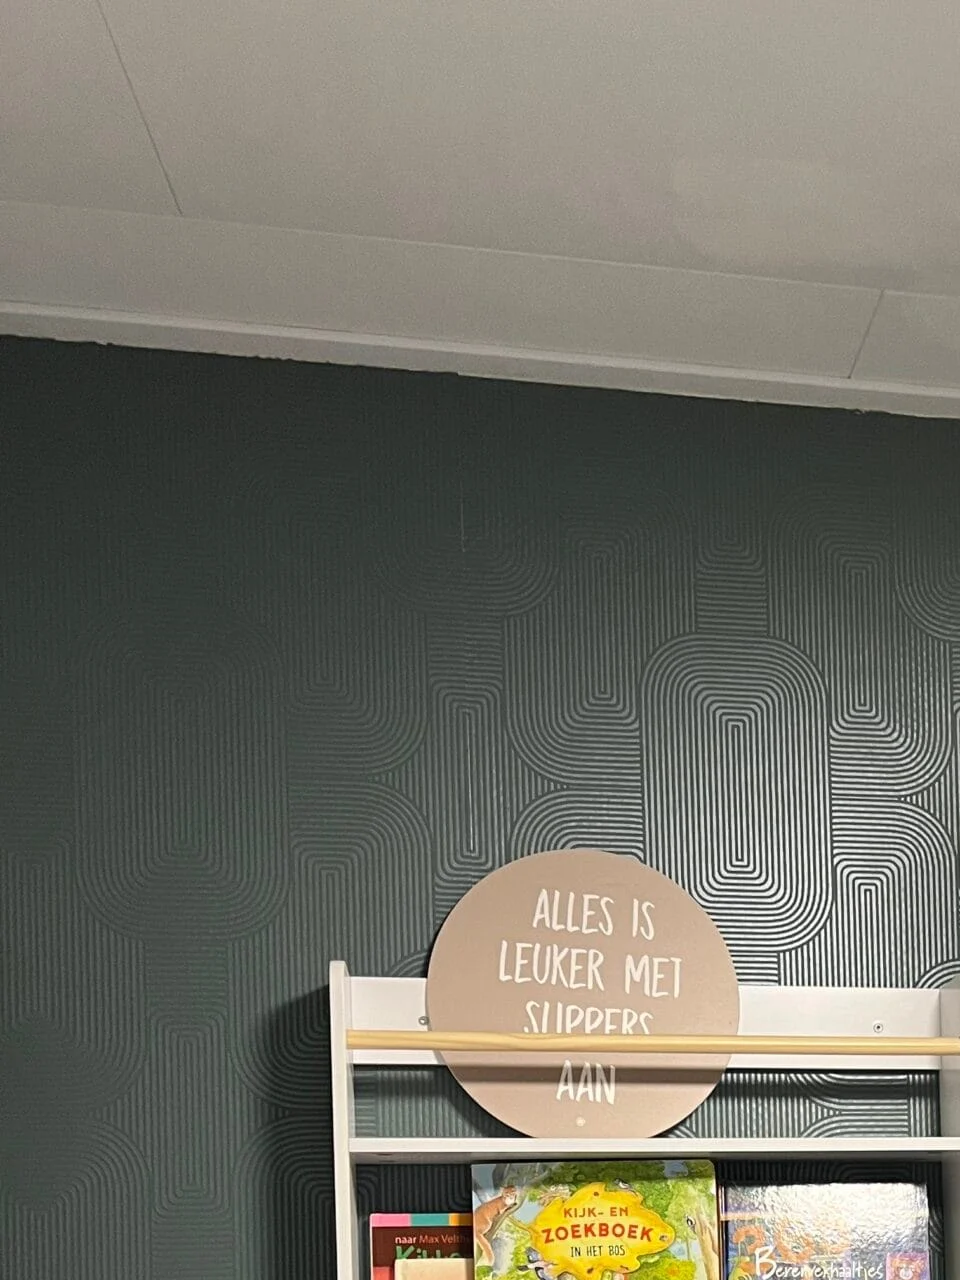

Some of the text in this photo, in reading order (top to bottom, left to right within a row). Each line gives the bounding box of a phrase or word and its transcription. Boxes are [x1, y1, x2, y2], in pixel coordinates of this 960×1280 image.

[533, 889, 656, 940] ALLES IS
[499, 940, 682, 999] LEUKER MET
[556, 1060, 616, 1105] AAN
[609, 1206, 629, 1217] EN
[395, 1235, 417, 1244] naar
[419, 1234, 440, 1244] Max
[541, 1222, 654, 1245] ZOEKBOEK
[570, 1245, 626, 1257] IN HET BOS
